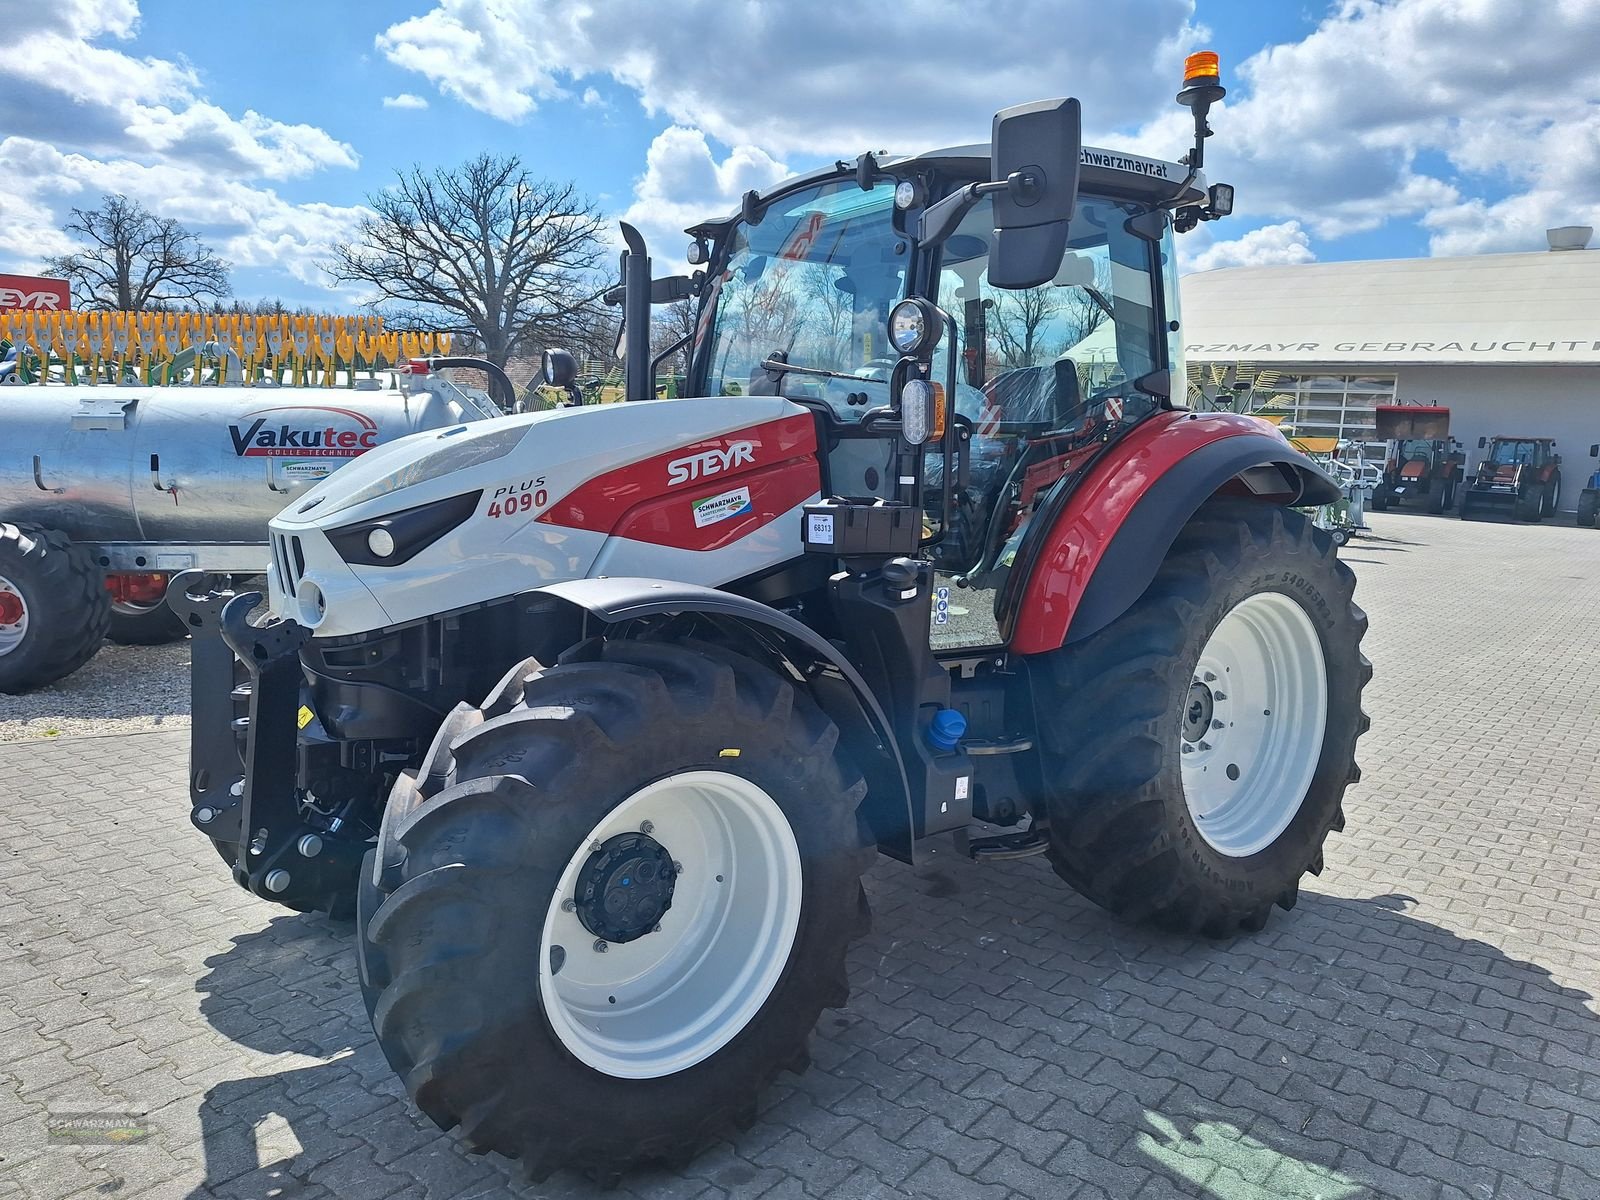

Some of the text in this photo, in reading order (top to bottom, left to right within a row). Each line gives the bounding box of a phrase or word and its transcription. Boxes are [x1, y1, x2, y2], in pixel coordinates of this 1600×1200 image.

[1080, 149, 1168, 178] chwarzmayr.at
[0, 287, 61, 311] EYR
[228, 418, 378, 457] Vakutec
[667, 441, 756, 487] STEYR
[493, 475, 547, 499] PLUS
[487, 489, 548, 519] 4090
[697, 494, 742, 513] SCHWARZMAYR
[813, 523, 832, 533] 68313
